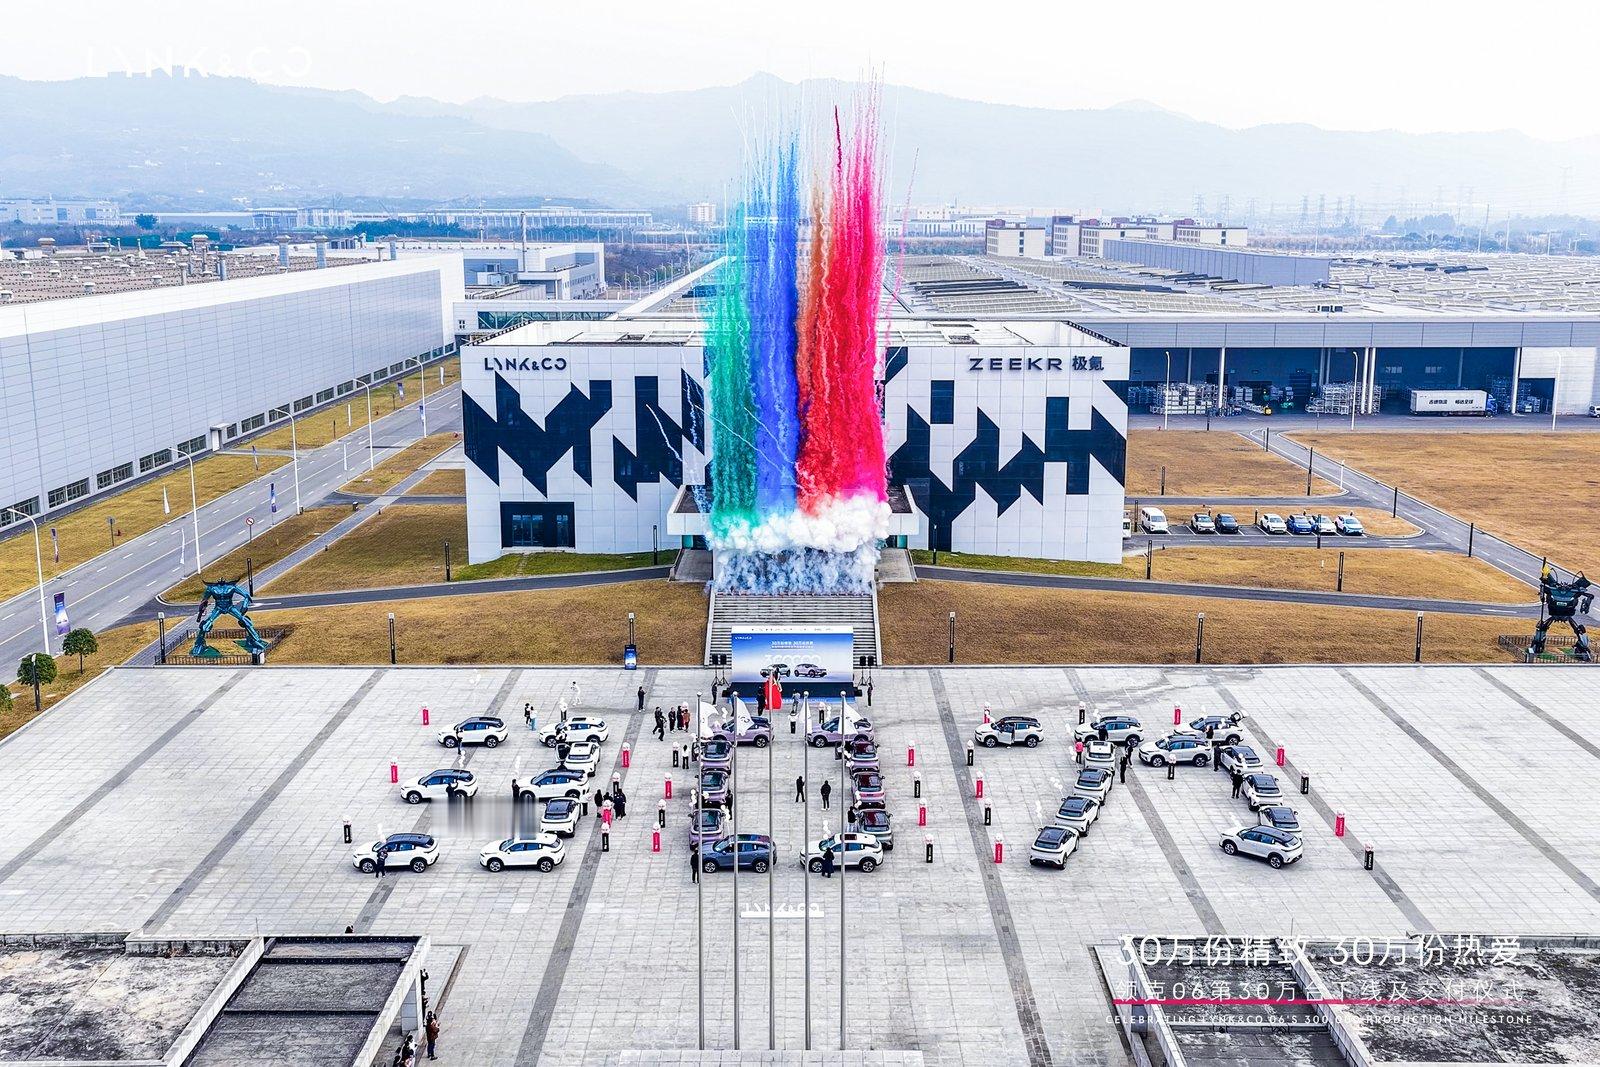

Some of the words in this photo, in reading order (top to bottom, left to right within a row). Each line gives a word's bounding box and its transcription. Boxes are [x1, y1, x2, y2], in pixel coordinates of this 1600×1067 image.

[484, 357, 567, 371] LYNK&CO
[969, 357, 1063, 371] ZEEKR
[1071, 355, 1105, 371] 极氪
